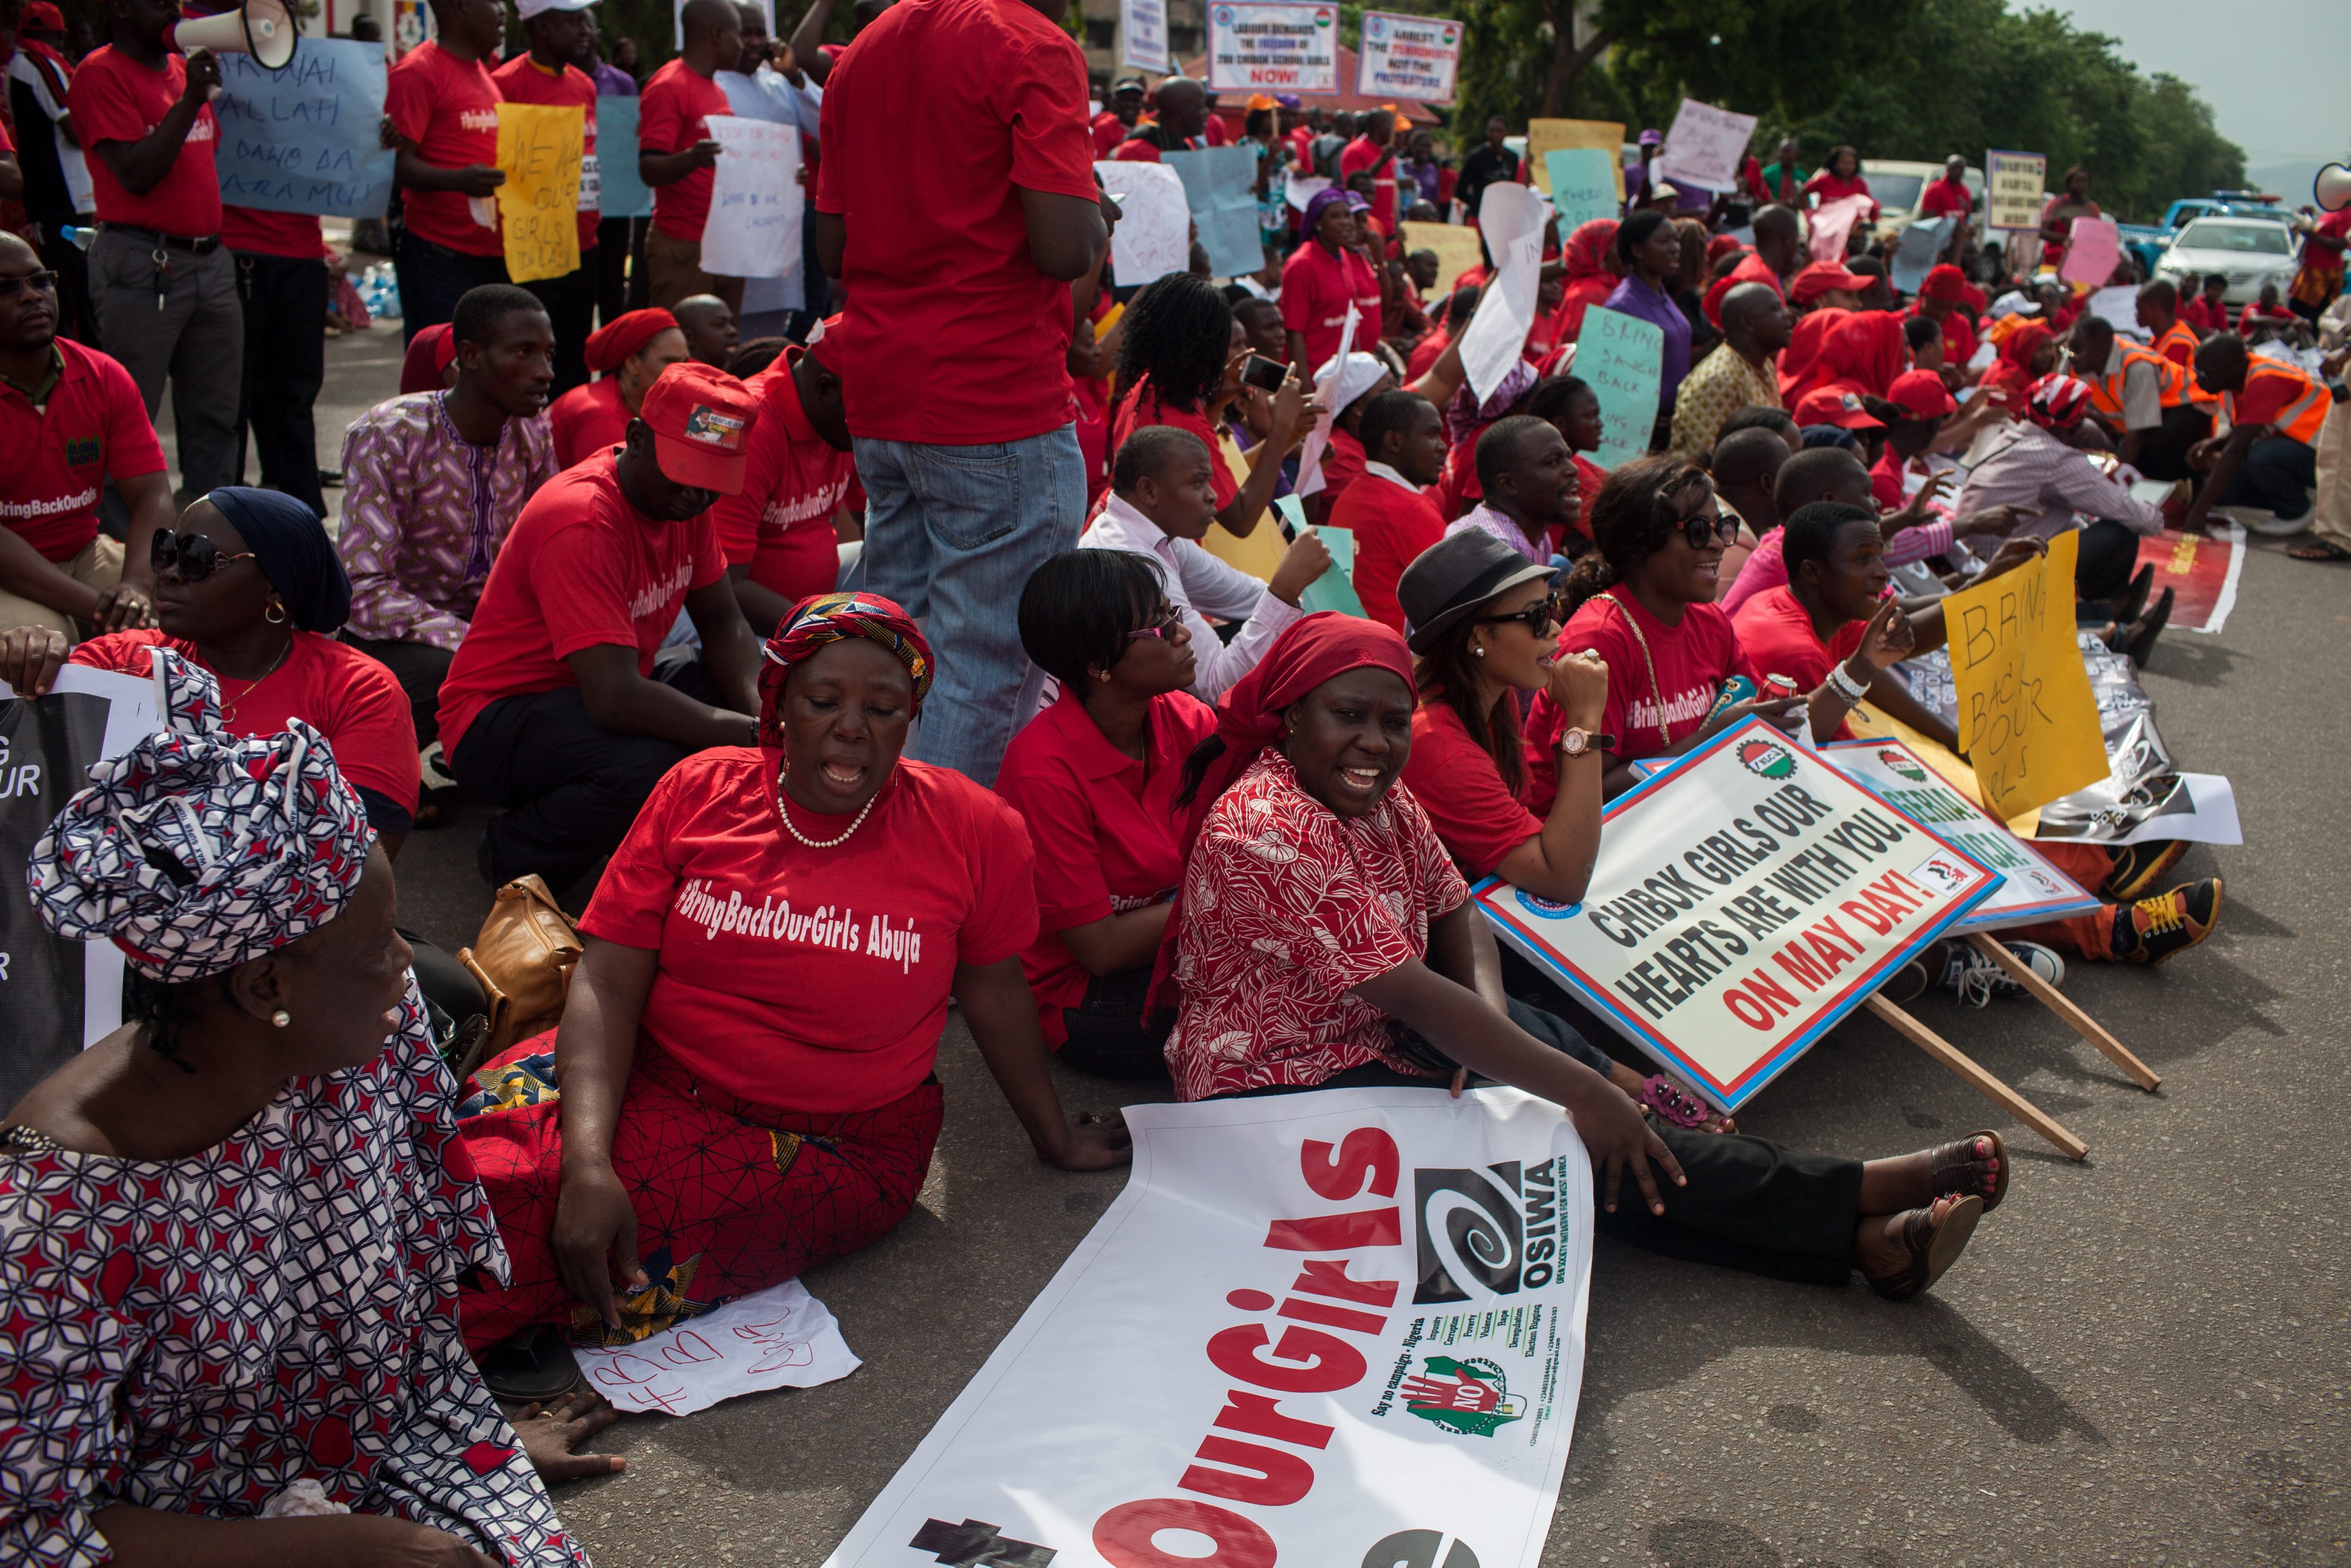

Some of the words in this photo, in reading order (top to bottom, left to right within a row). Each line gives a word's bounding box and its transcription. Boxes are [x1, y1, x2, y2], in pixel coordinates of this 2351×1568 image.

[1989, 677, 2053, 756] OUR
[1588, 864, 1715, 948] CHIBOK
[1683, 818, 1780, 885] GIRLS
[1753, 783, 1833, 837] OUR
[674, 878, 860, 952] #BringBackOurGirls
[866, 915, 922, 975] Abuja
[1613, 919, 1749, 1020] HEARTS
[1719, 884, 1801, 941] ARE
[1764, 843, 1859, 906] WITH
[1823, 808, 1911, 863] YOU.
[1722, 967, 1802, 1031] ON
[1771, 914, 1867, 992] MAY
[1838, 868, 1935, 937] DAY!
[1523, 1158, 1556, 1289] OSIWA
[1426, 1315, 1444, 1341] Impunity
[1444, 1315, 1460, 1346] Corruption
[1462, 1314, 1478, 1338] Poverty
[1479, 1311, 1493, 1339] Violence
[1497, 1309, 1508, 1327] Rape
[1508, 1307, 1523, 1349] Deregulation
[1530, 1303, 1542, 1328] Rigging
[1402, 1317, 1425, 1349] Nigeria
[1524, 1328, 1538, 1358] Election
[1390, 1348, 1413, 1384] campaign
[1386, 1383, 1396, 1399] no
[1452, 1385, 1485, 1411] NO
[1371, 1400, 1389, 1418] Say
